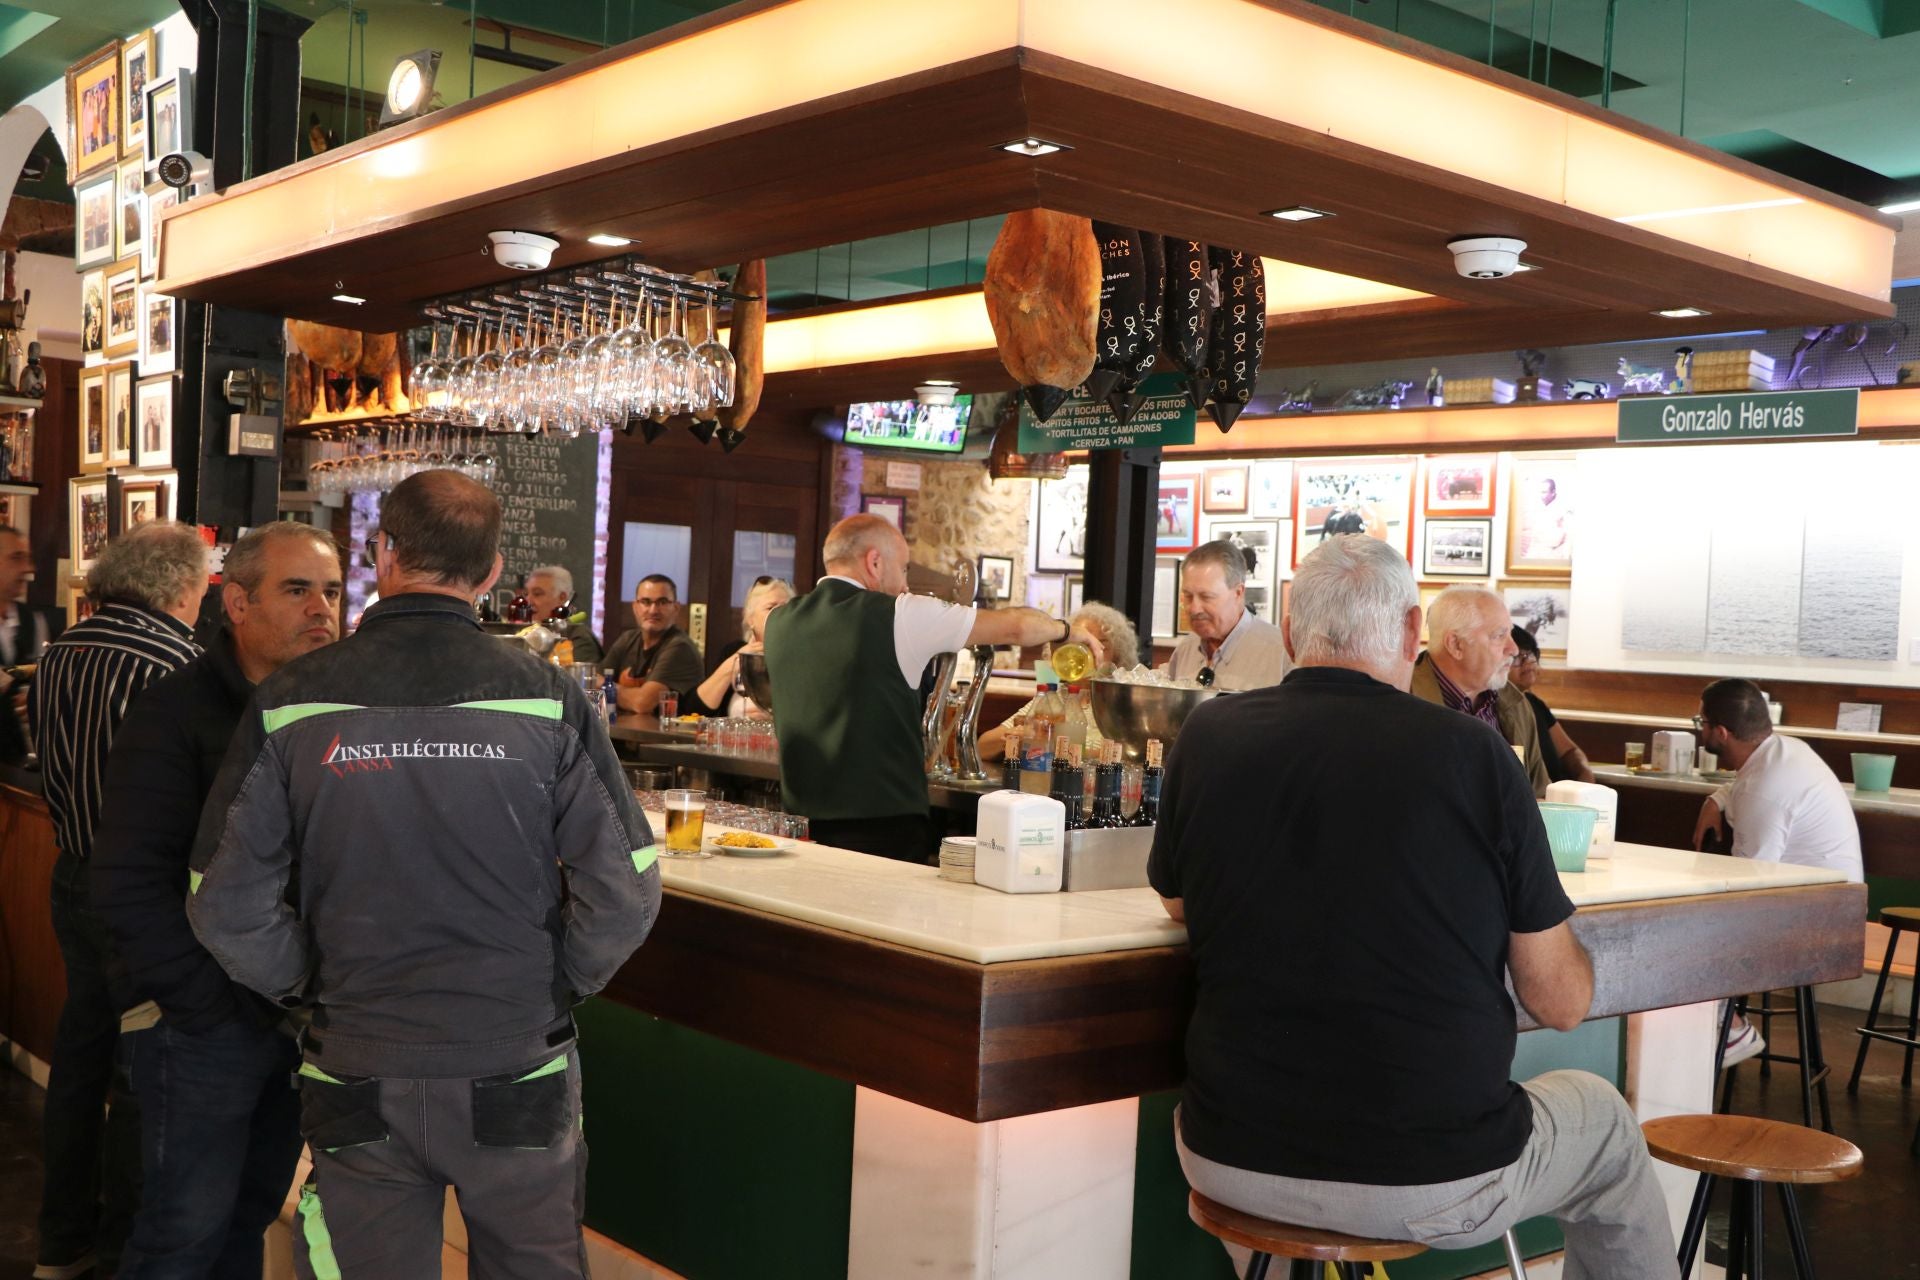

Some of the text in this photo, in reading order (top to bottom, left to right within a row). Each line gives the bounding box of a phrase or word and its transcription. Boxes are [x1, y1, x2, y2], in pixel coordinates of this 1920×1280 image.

[1075, 403, 1113, 416] BOCARTE
[1156, 398, 1187, 409] FRITOS
[1073, 417, 1101, 427] FRITOS
[1138, 412, 1150, 422] EN
[1150, 410, 1182, 421] ADOBO
[1661, 401, 1805, 433] Gonzalo Hervás
[1051, 423, 1162, 439] TORTILLITAS DE CAMARONES
[1075, 435, 1134, 448] CERVEZA PAN
[505, 443, 561, 459] RESERVA
[507, 457, 558, 472] LEONES
[340, 738, 506, 761] INST. ELÉCTRICAS
